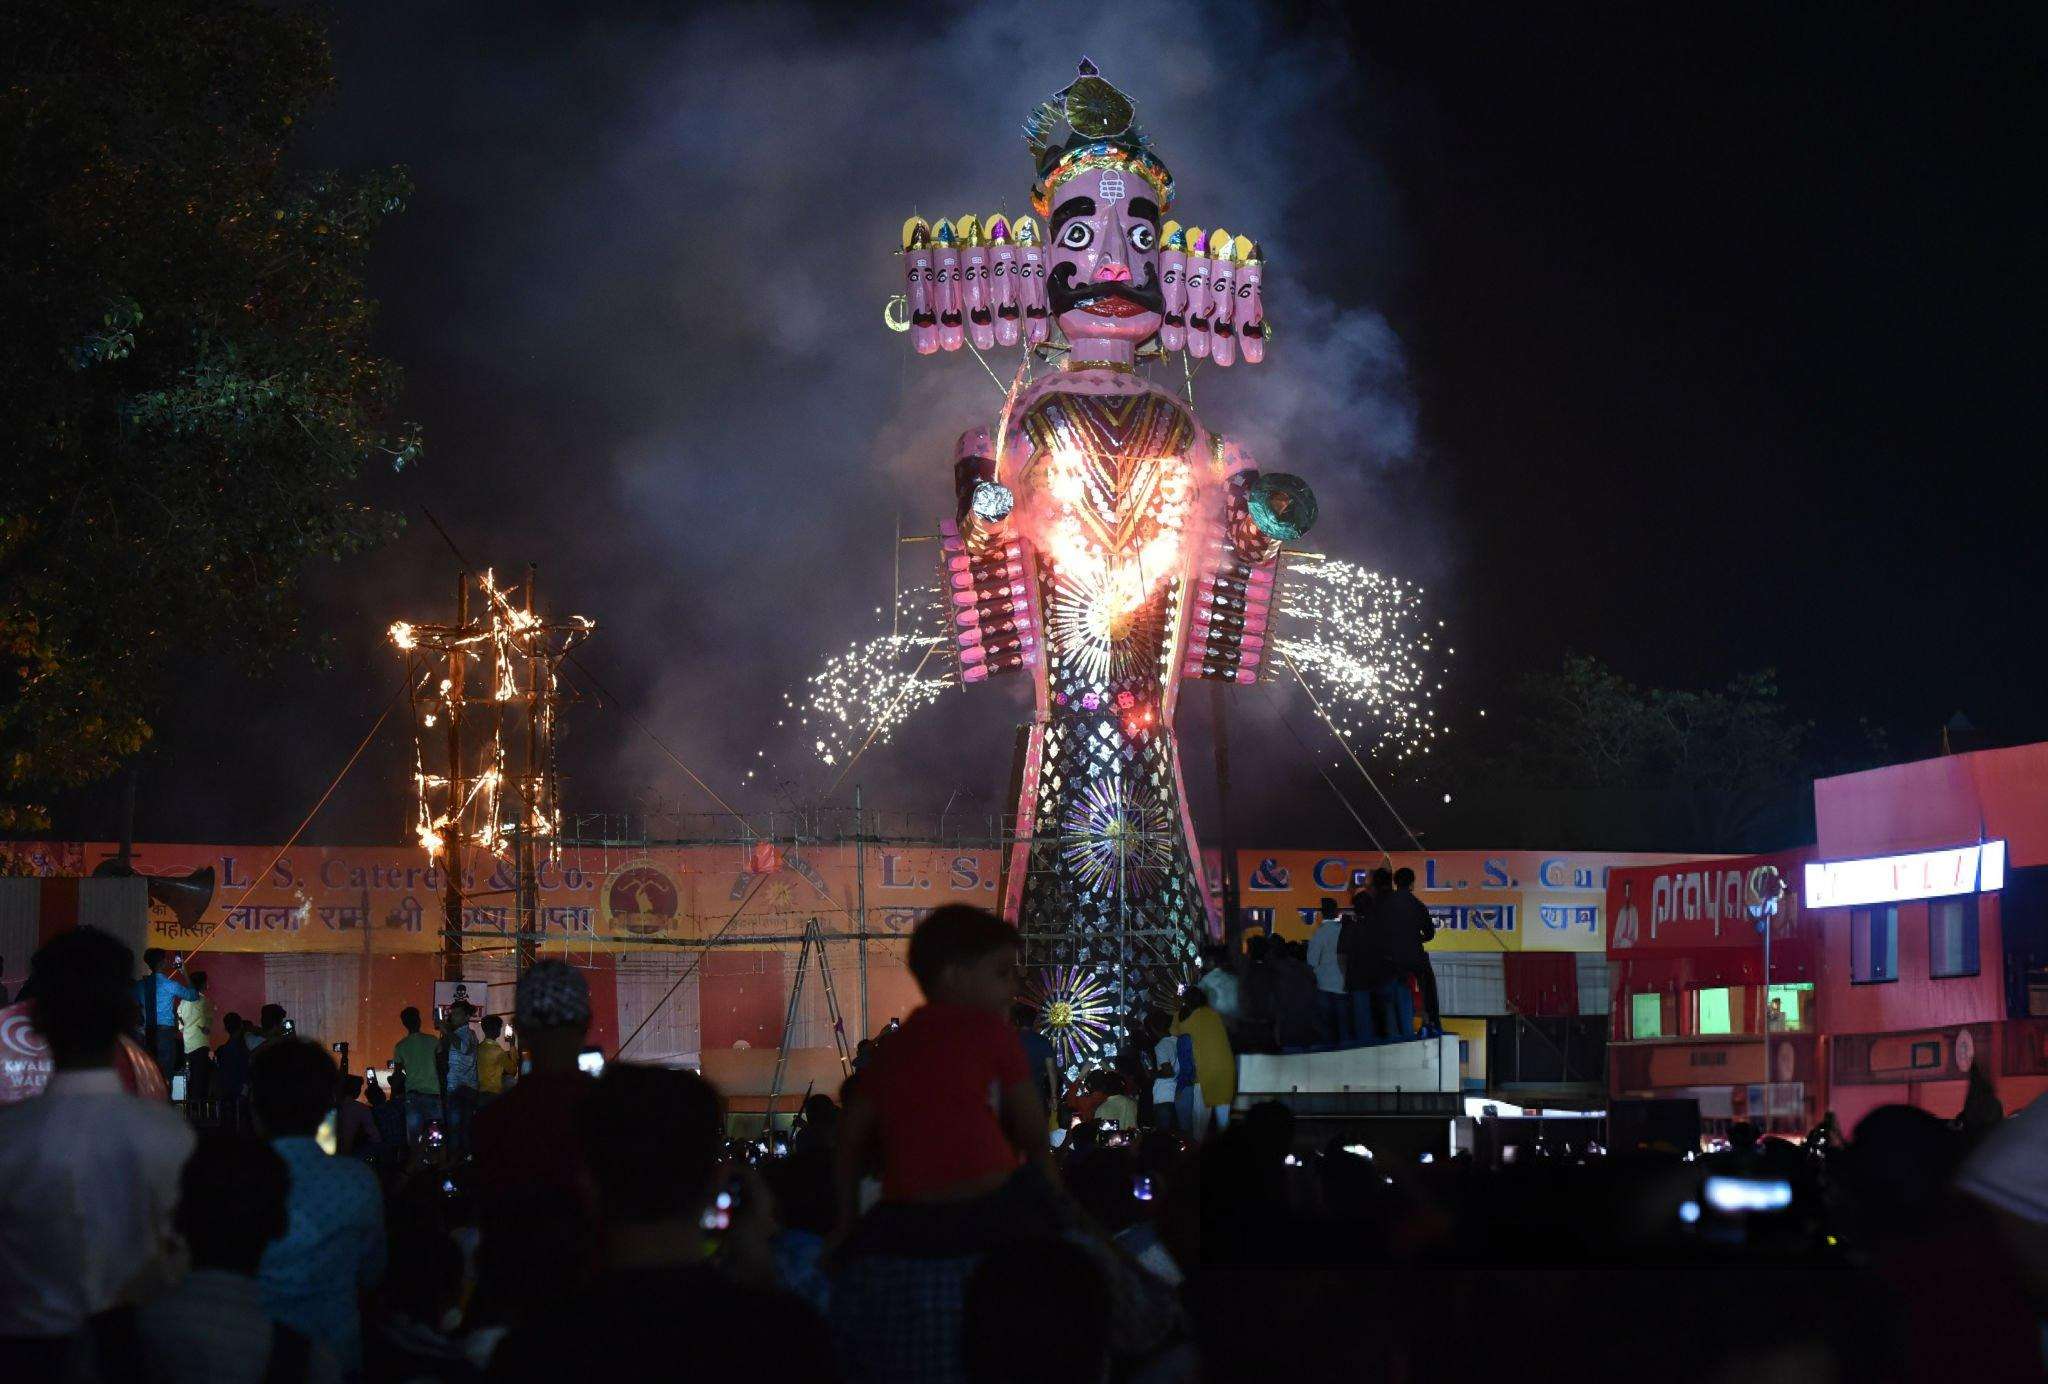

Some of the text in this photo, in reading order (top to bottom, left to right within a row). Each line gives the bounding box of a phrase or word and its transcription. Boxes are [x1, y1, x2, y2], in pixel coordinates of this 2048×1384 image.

[321, 860, 475, 889] Cateres
[880, 855, 995, 889] L. S.
